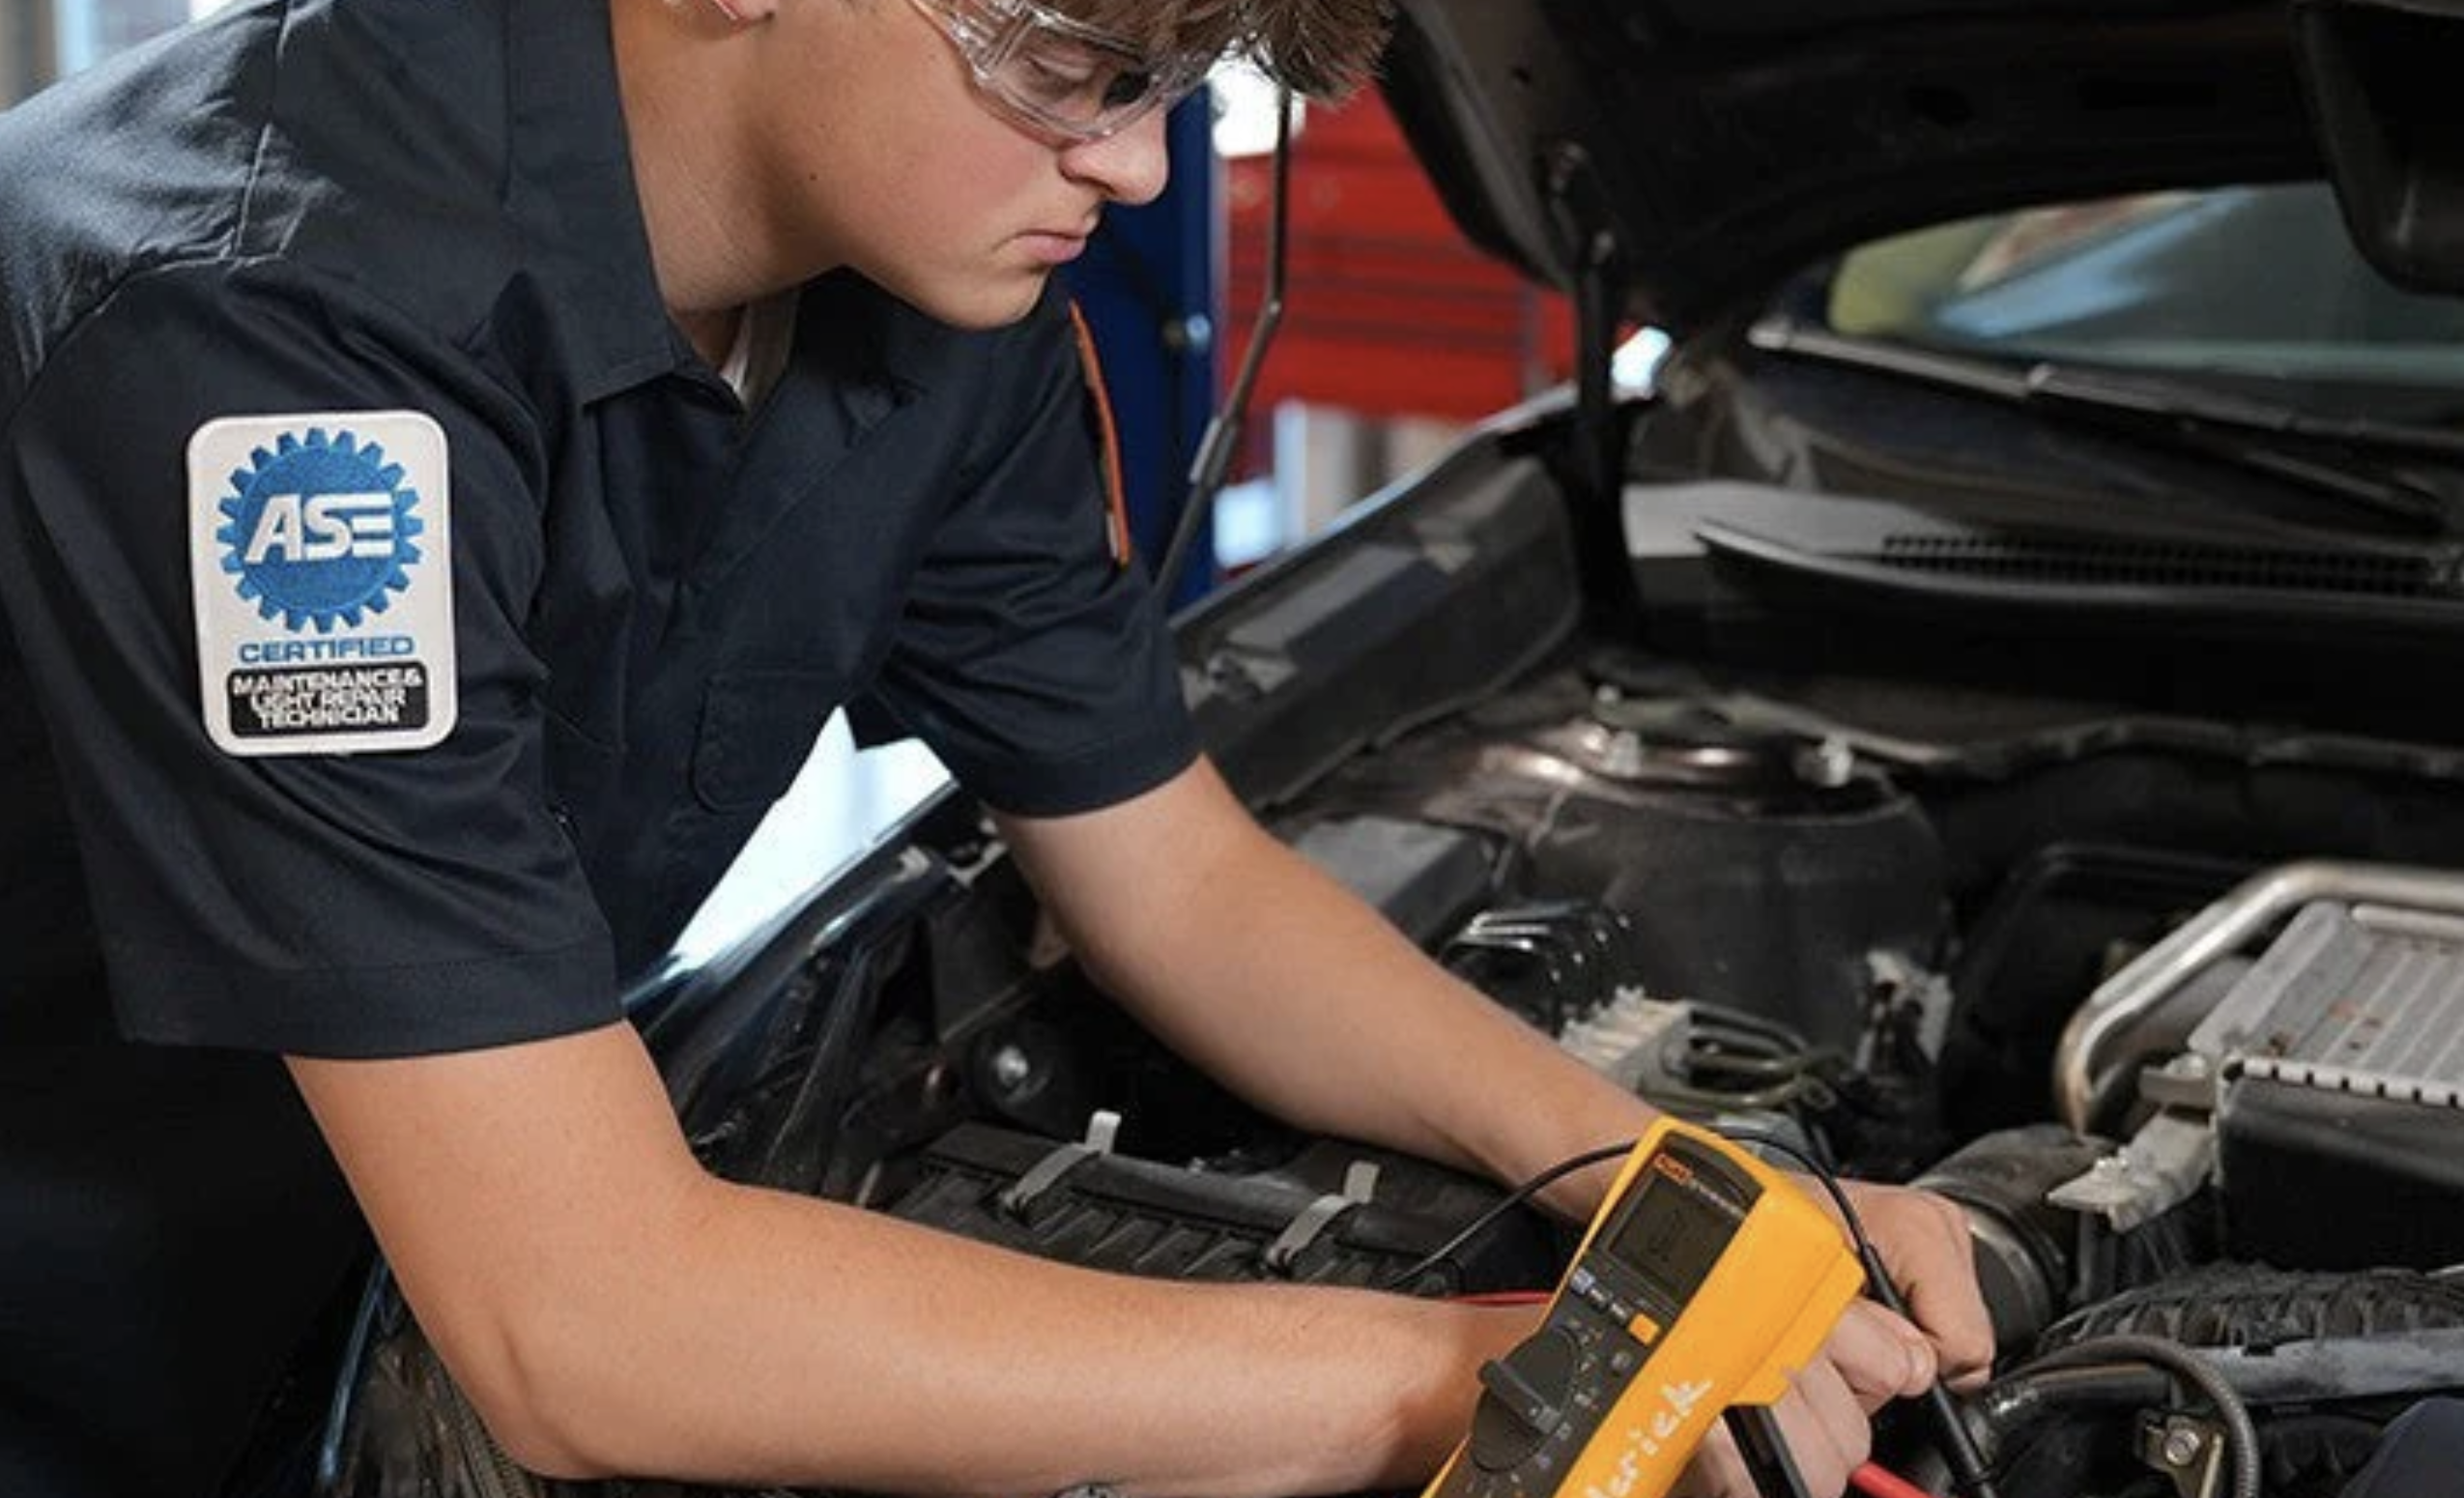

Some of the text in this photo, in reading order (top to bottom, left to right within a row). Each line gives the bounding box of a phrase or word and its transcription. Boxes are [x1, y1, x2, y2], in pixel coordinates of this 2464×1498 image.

[244, 493, 395, 563] ASE
[240, 636, 415, 663] CERTIFIED
[321, 687, 406, 710] REPAIR
[260, 706, 400, 730] TECHNICIAN
